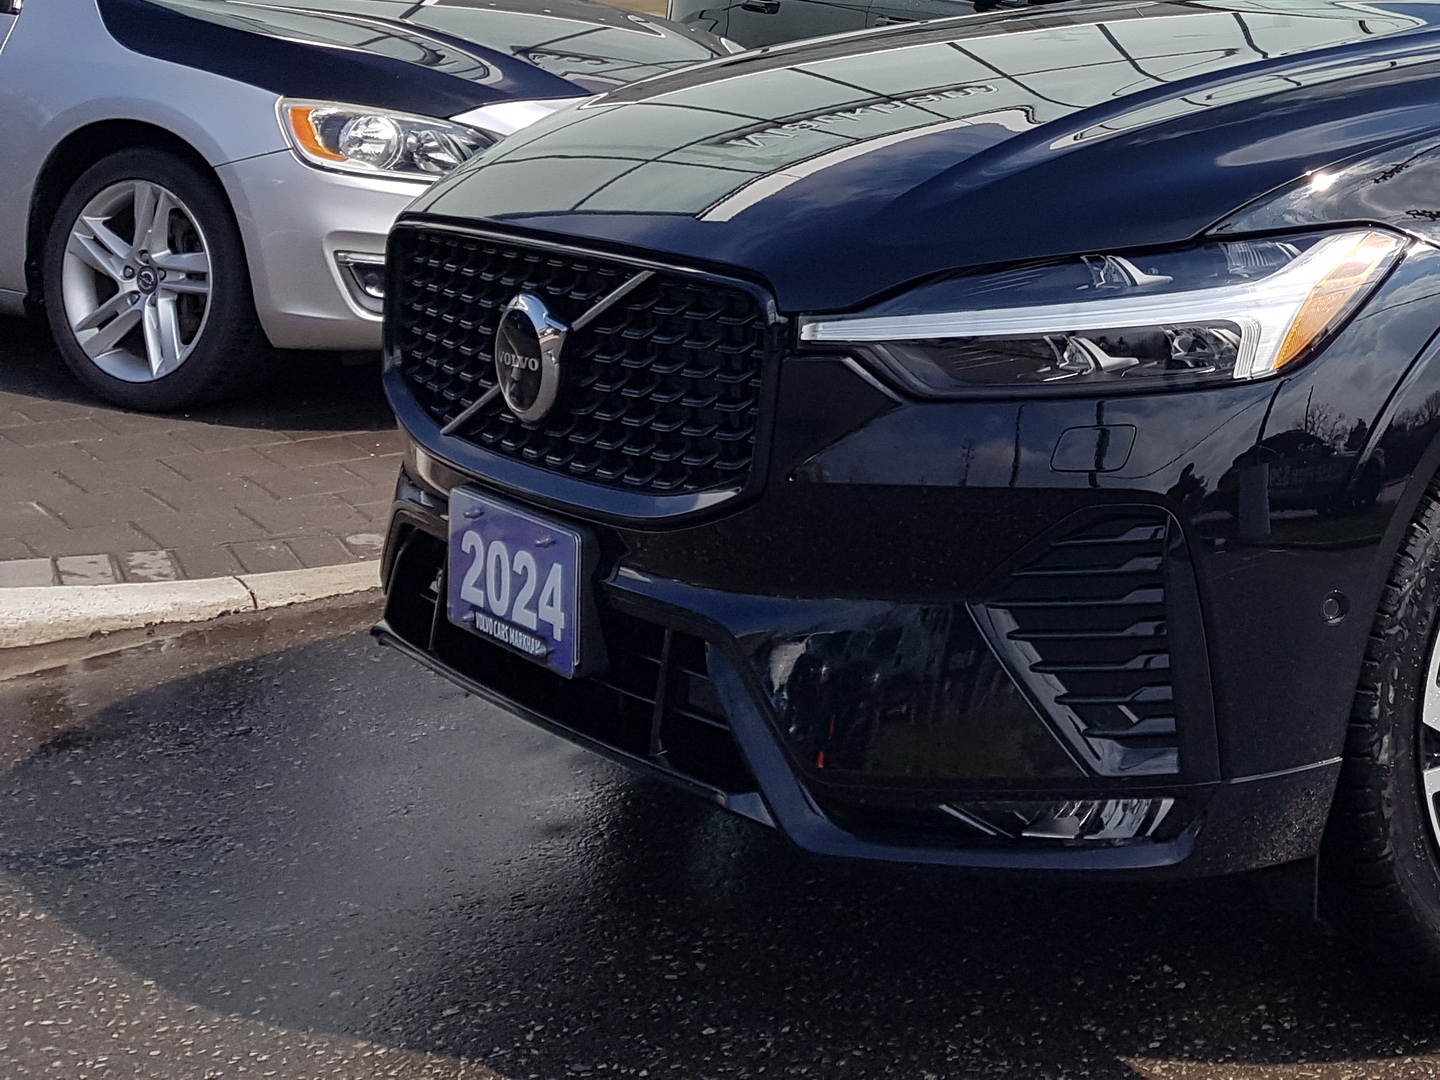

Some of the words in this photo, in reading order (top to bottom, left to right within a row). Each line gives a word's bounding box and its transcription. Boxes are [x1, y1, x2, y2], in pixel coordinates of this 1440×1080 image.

[498, 351, 540, 372] VOLVO
[460, 530, 566, 642] 2024
[475, 611, 493, 635] VOLVO
[493, 620, 509, 642] CARS
